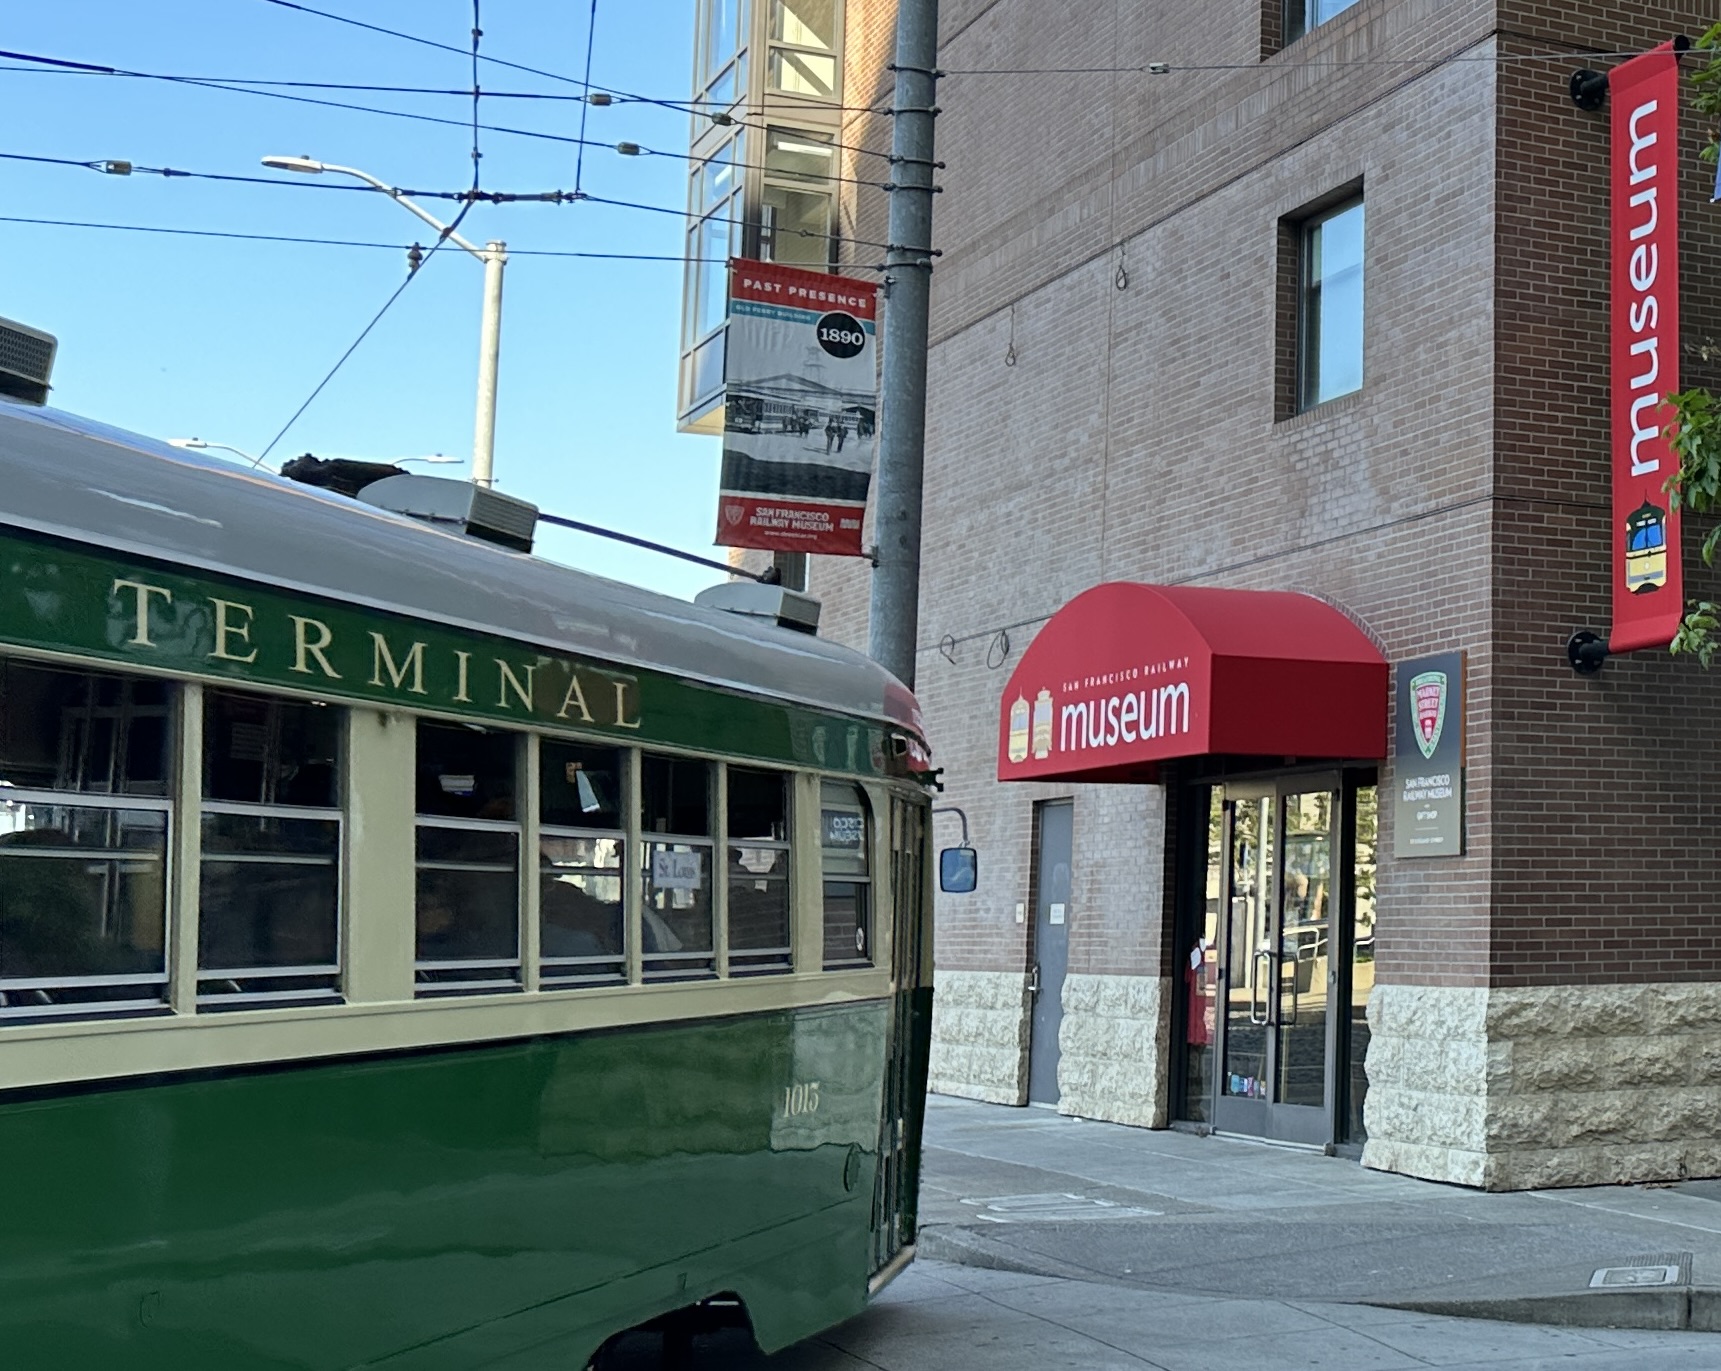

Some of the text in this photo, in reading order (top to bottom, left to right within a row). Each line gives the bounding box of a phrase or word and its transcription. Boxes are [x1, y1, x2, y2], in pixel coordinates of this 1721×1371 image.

[743, 278, 867, 308] PAST PRESENCE
[1629, 99, 1659, 477] museum
[820, 327, 864, 346] 1890
[749, 516, 790, 528] RAILWAY
[791, 520, 834, 532] MUSEUM
[756, 507, 830, 521] SAN FRANCISCO
[113, 578, 642, 729] TERMINAL
[1063, 656, 1190, 693] SAN FRANCISCO RAILWAY
[1060, 682, 1190, 752] museum
[783, 1081, 820, 1118] 1015
